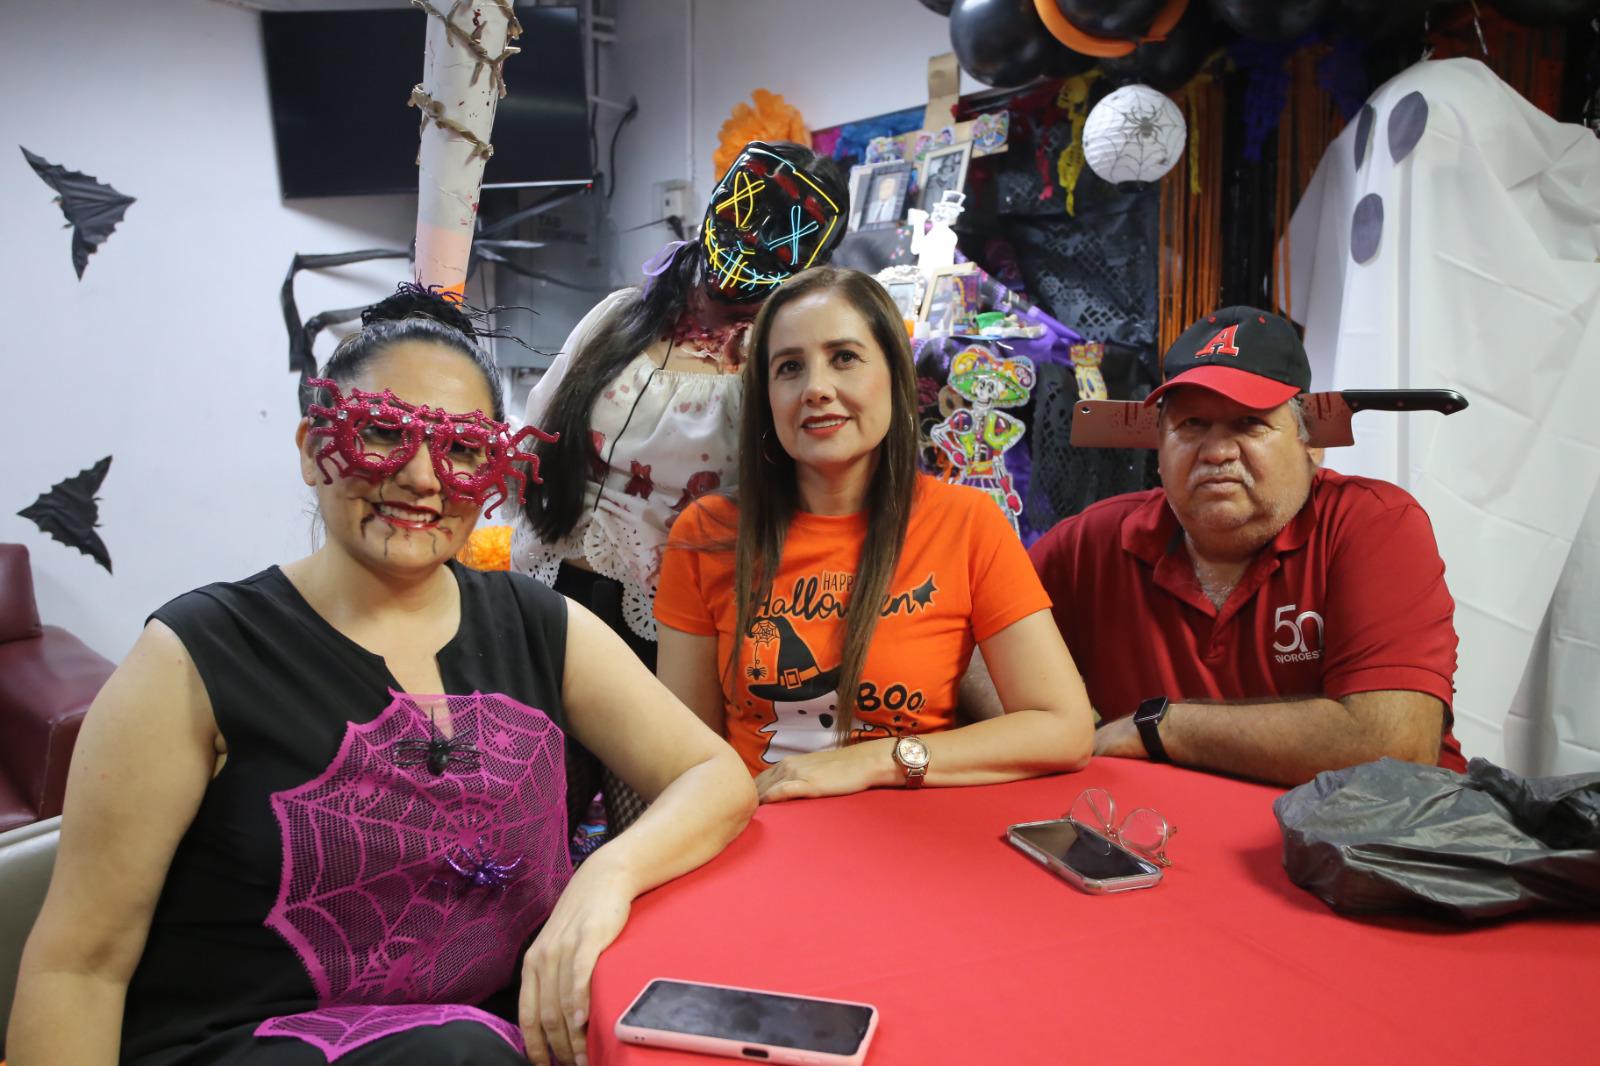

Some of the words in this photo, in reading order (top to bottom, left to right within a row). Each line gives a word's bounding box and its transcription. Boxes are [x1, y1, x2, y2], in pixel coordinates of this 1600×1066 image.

[1194, 324, 1239, 358] A
[822, 571, 856, 592] HAPP
[1273, 604, 1325, 653] 50
[1275, 649, 1322, 664] NOROES
